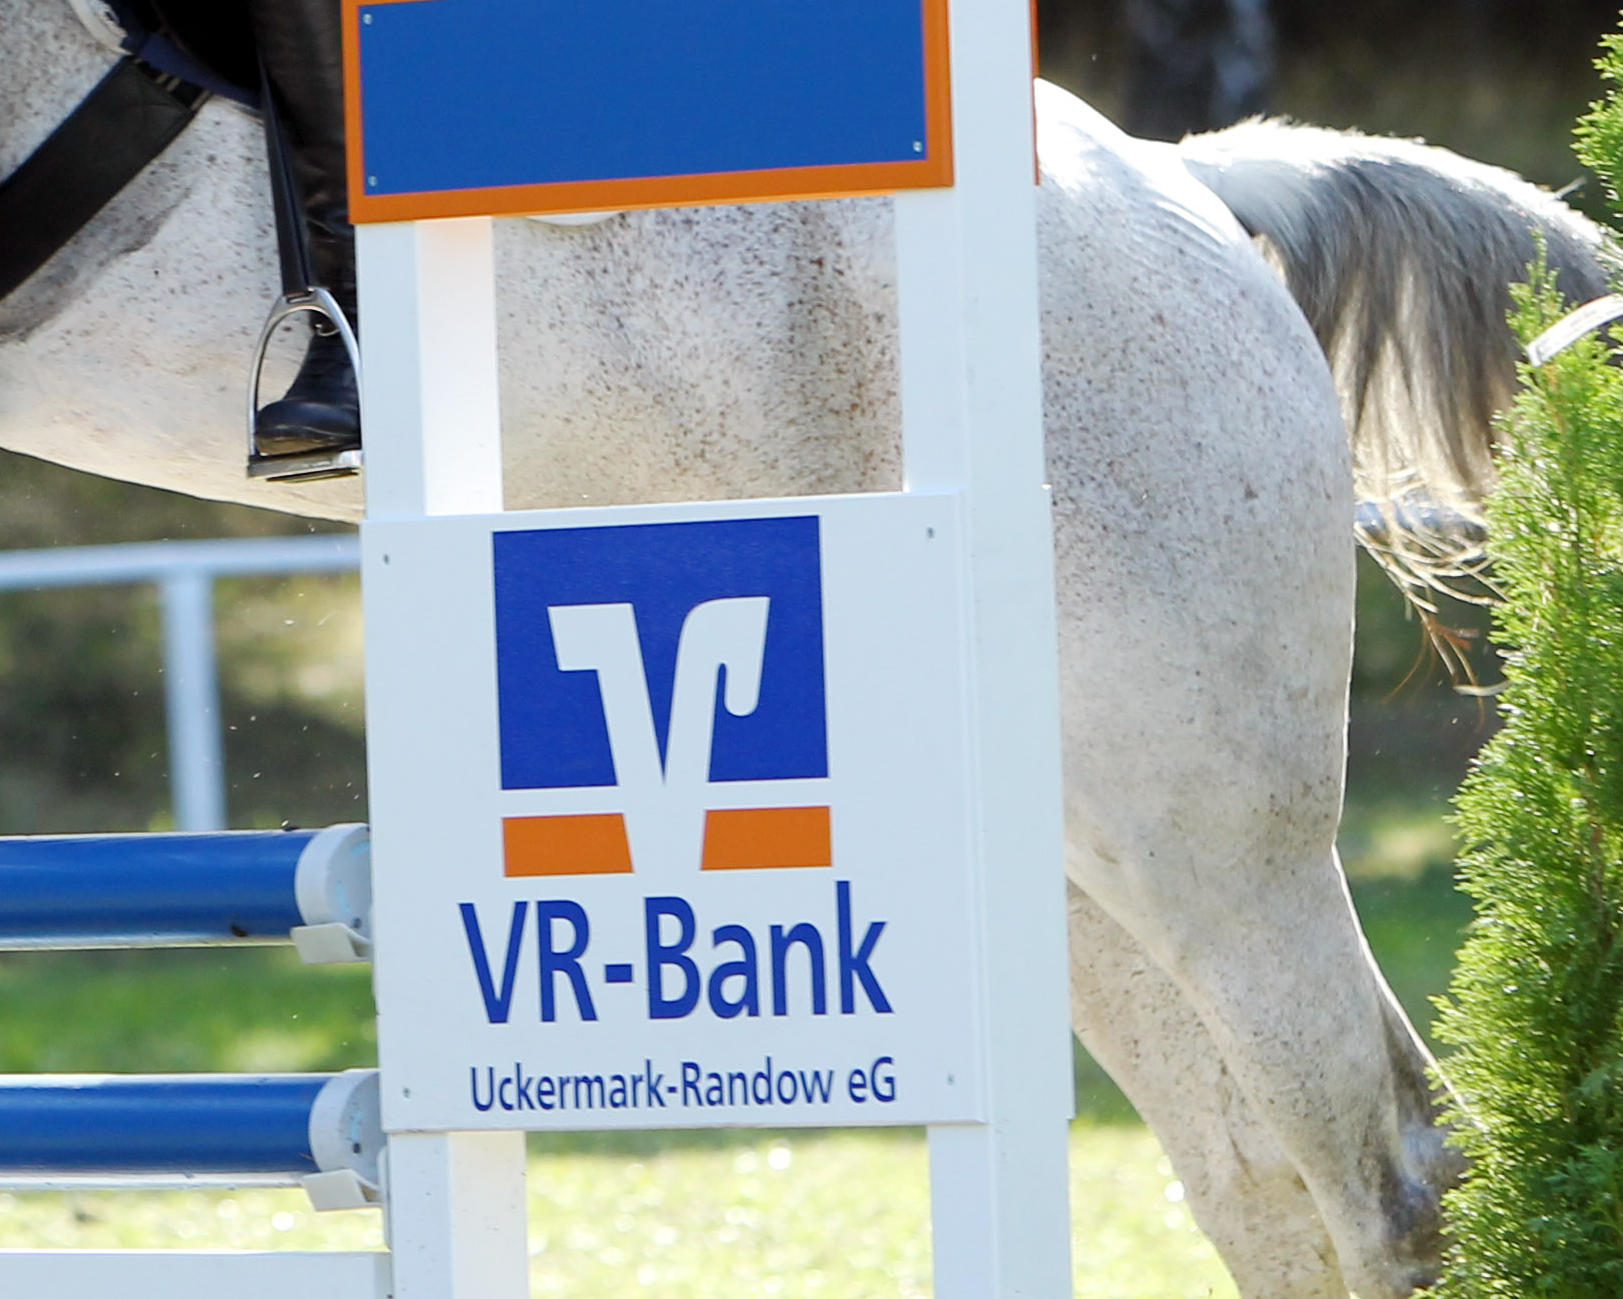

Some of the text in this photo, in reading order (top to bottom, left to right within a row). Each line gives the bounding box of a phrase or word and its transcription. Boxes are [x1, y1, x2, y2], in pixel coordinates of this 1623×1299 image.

[458, 880, 894, 1024] VR-Bank
[470, 1056, 896, 1112] Uckermark-Randow eG
